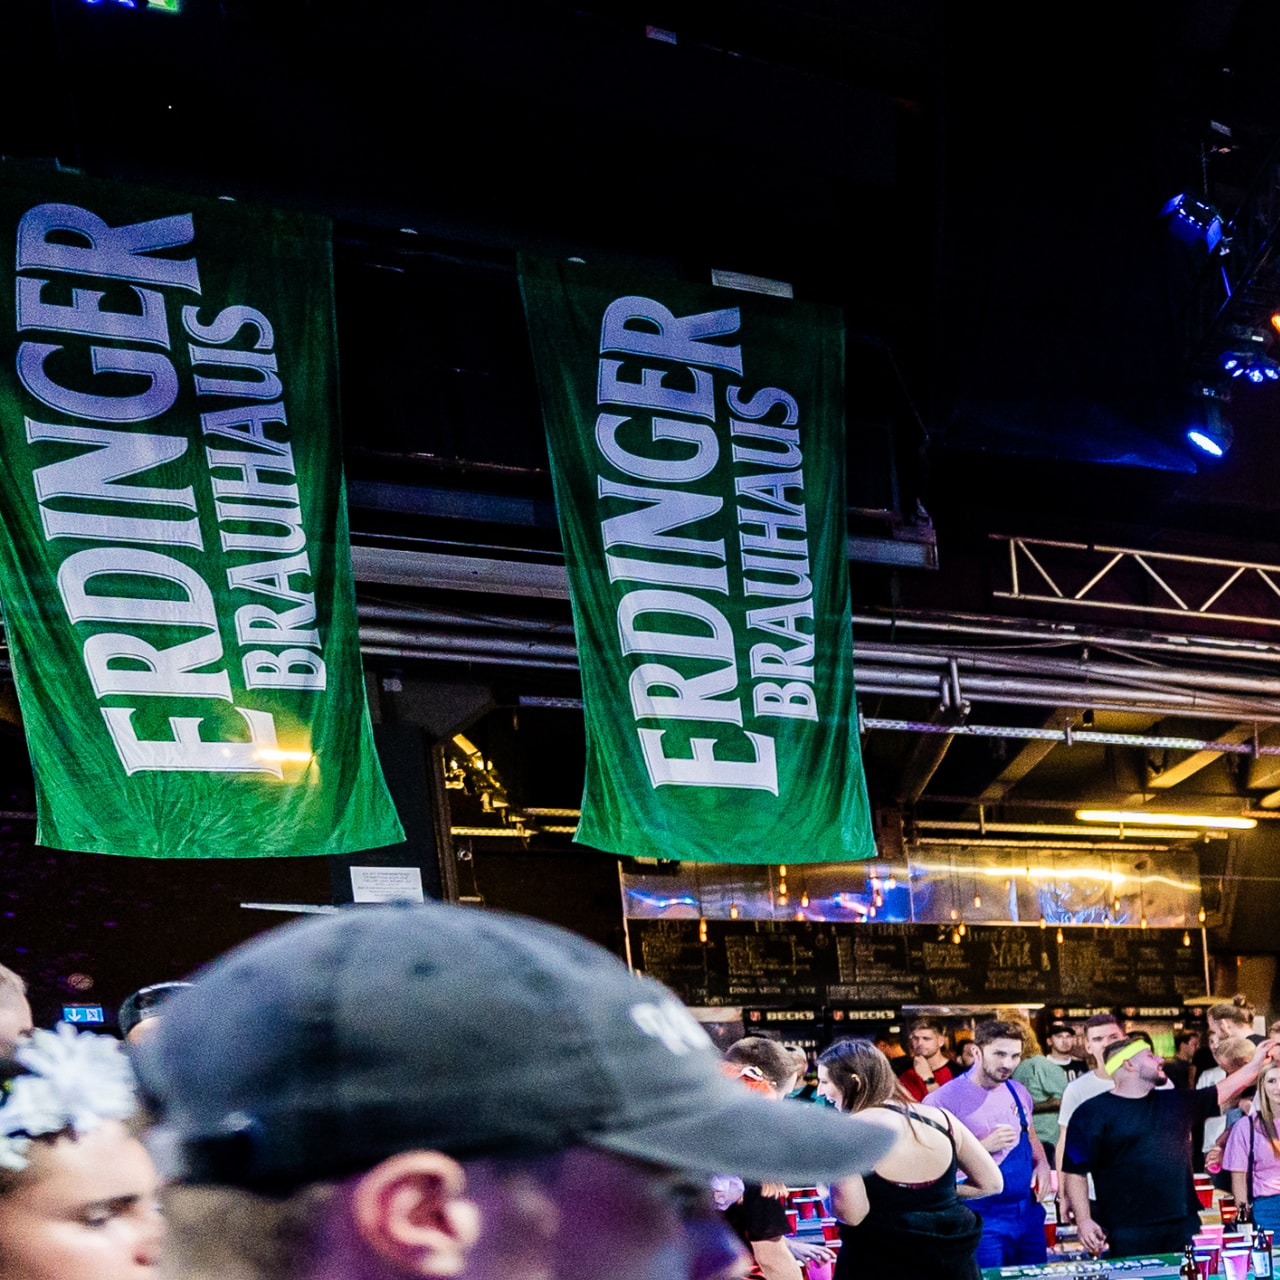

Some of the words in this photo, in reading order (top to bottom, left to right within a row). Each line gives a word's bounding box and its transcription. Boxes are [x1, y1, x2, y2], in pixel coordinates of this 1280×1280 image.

[16, 203, 284, 779] ERDINGER
[182, 304, 327, 691] BRAUHAUS
[596, 296, 780, 797] ERDINGER
[727, 386, 819, 722] BRAUHAUS
